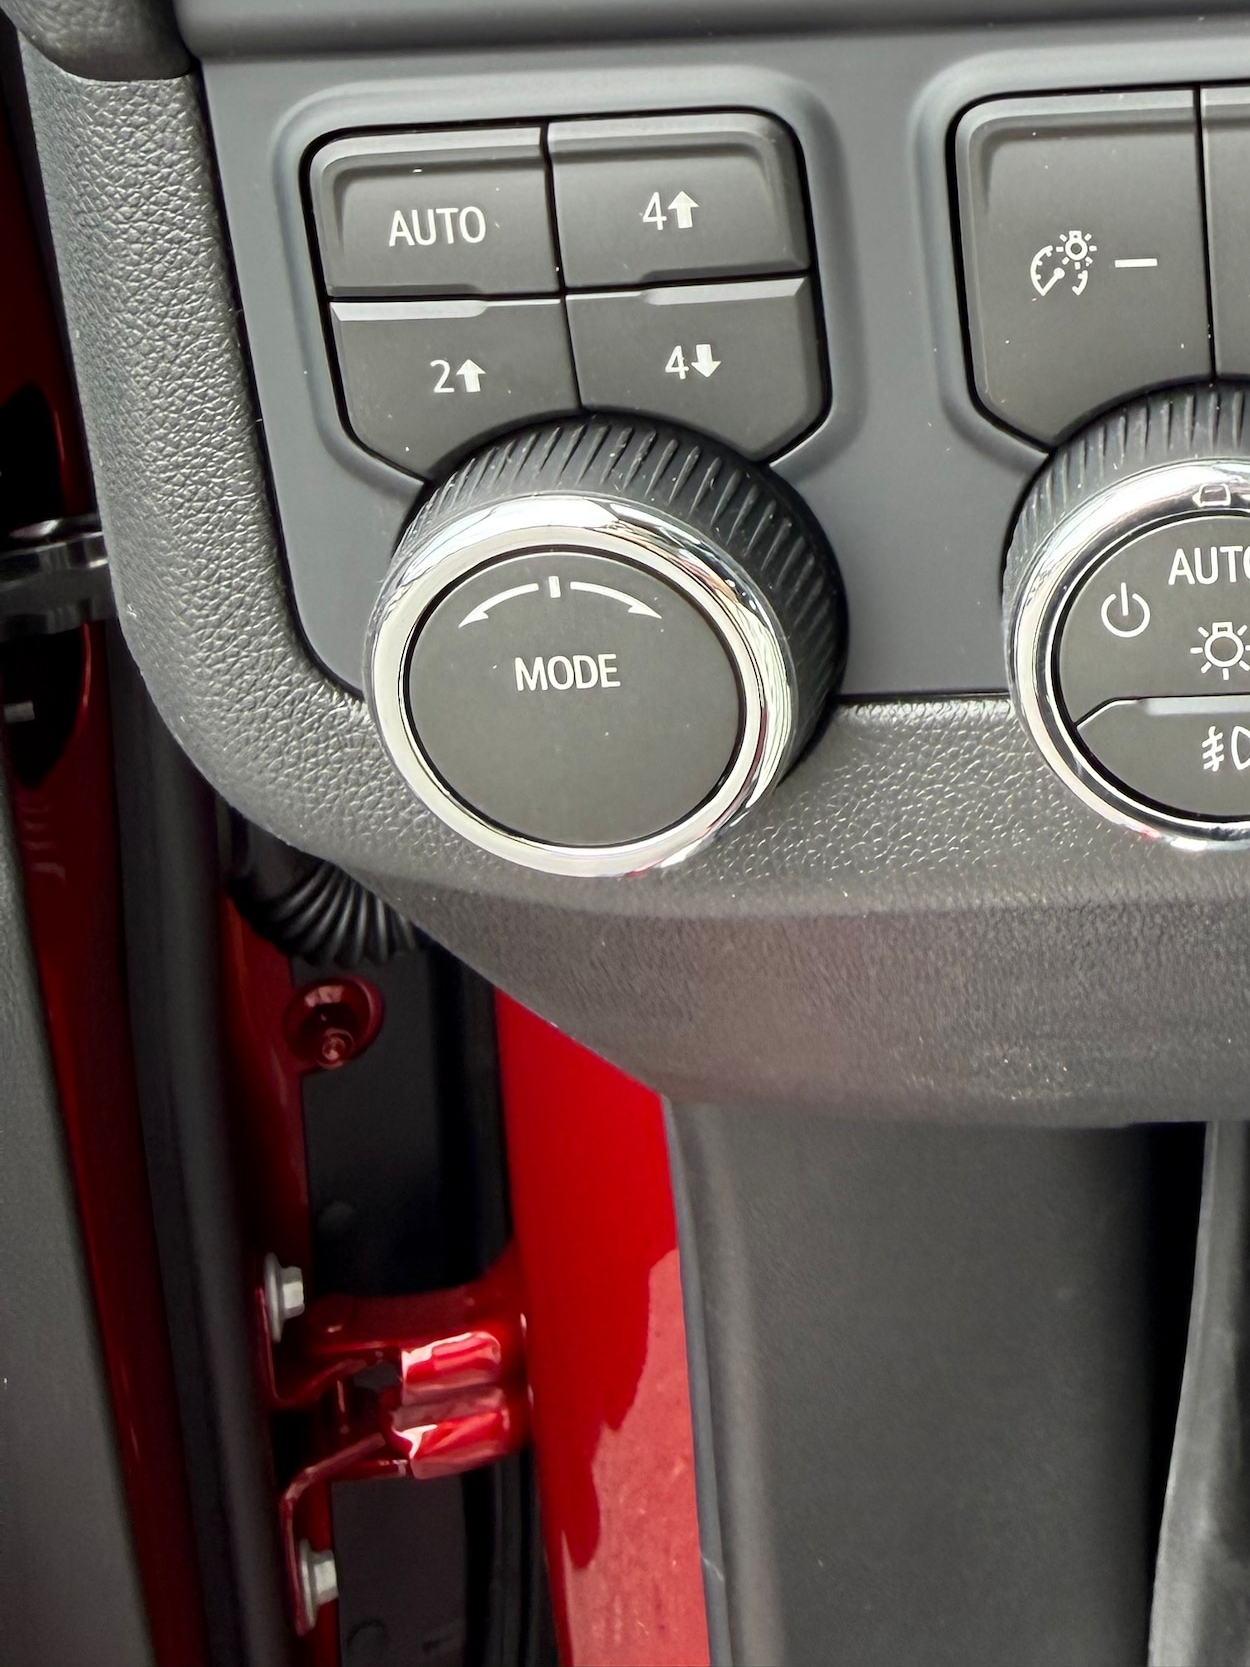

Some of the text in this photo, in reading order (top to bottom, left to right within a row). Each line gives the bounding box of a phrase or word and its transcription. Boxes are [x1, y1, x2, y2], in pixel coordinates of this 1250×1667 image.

[388, 206, 486, 247] AUTO
[642, 191, 667, 231] 4
[430, 359, 455, 393] 2
[664, 345, 690, 380] 4
[514, 653, 621, 692] MODE
